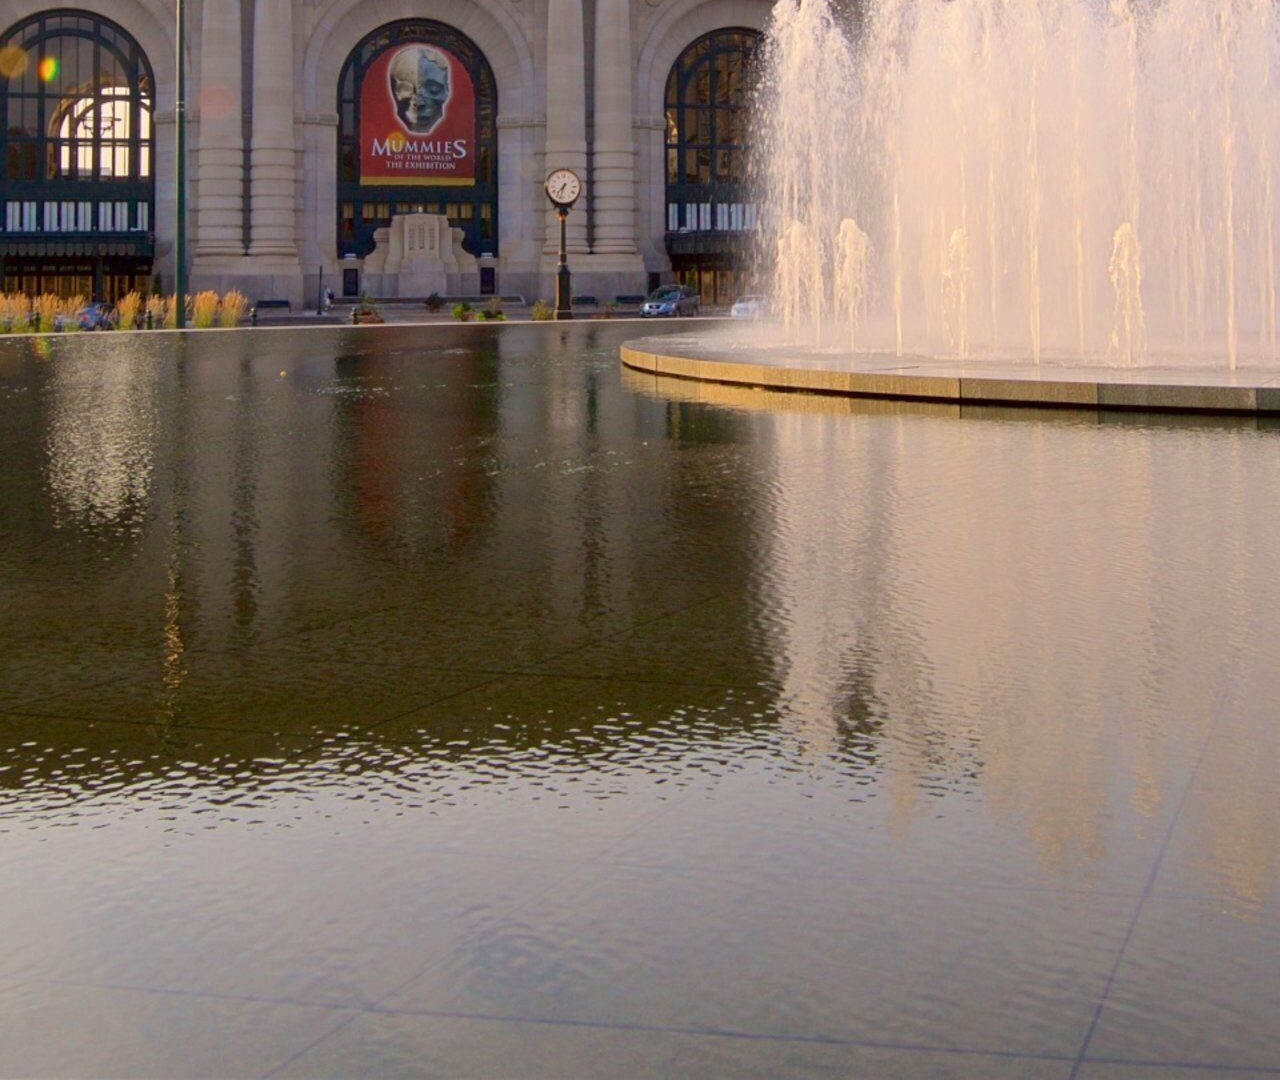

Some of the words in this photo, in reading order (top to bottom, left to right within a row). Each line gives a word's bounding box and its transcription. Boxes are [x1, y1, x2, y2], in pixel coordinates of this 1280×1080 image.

[371, 138, 467, 159] MUMMIES
[386, 161, 402, 169] THE
[405, 161, 456, 170] EXHIBITION
